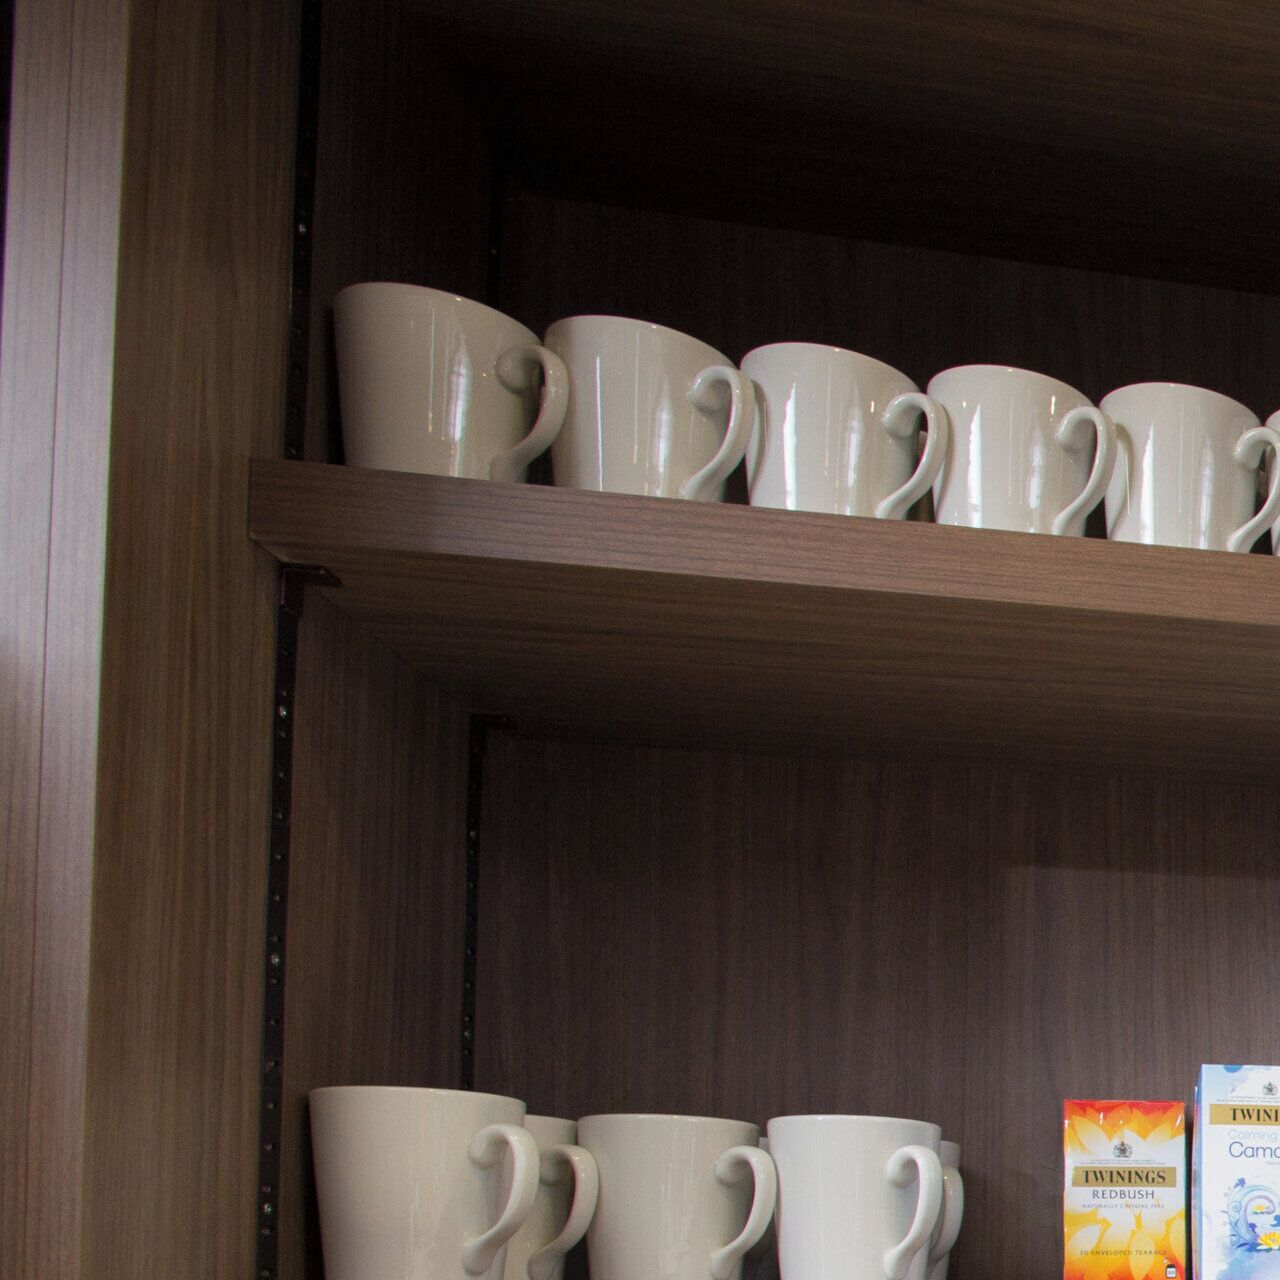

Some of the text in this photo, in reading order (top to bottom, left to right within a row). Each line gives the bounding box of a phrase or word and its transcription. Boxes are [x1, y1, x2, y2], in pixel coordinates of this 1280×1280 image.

[1228, 1129, 1278, 1142] Calming
[1082, 1169, 1166, 1185] TWININGS
[1092, 1189, 1155, 1200] REDBUSH
